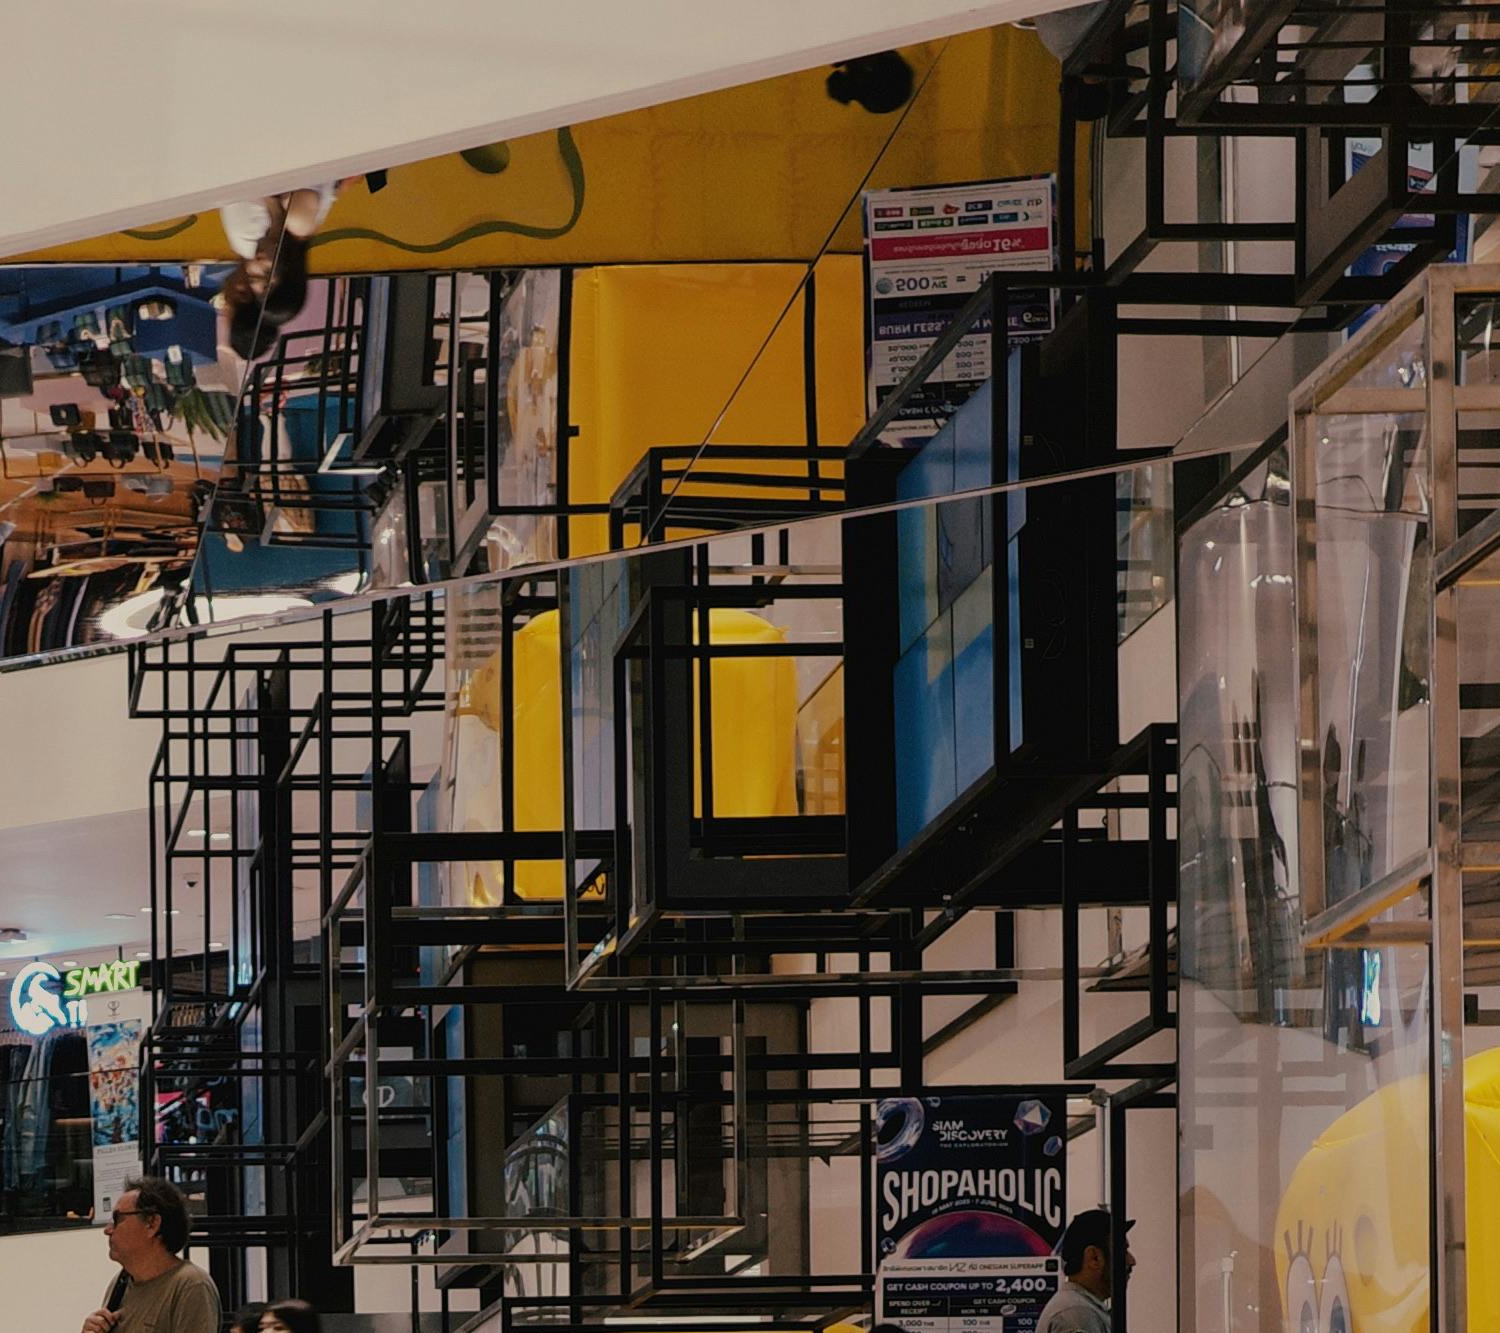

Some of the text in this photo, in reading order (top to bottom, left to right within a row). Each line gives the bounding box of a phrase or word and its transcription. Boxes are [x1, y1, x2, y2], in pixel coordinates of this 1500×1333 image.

[63, 959, 140, 996] SMART
[932, 1120, 964, 1132] SIAM
[939, 1129, 1009, 1141] DISCOVERY
[882, 1167, 1061, 1232] SHOPAHOLIC
[886, 1278, 1047, 1294] GET CASH COUPON UP TO 2,400
